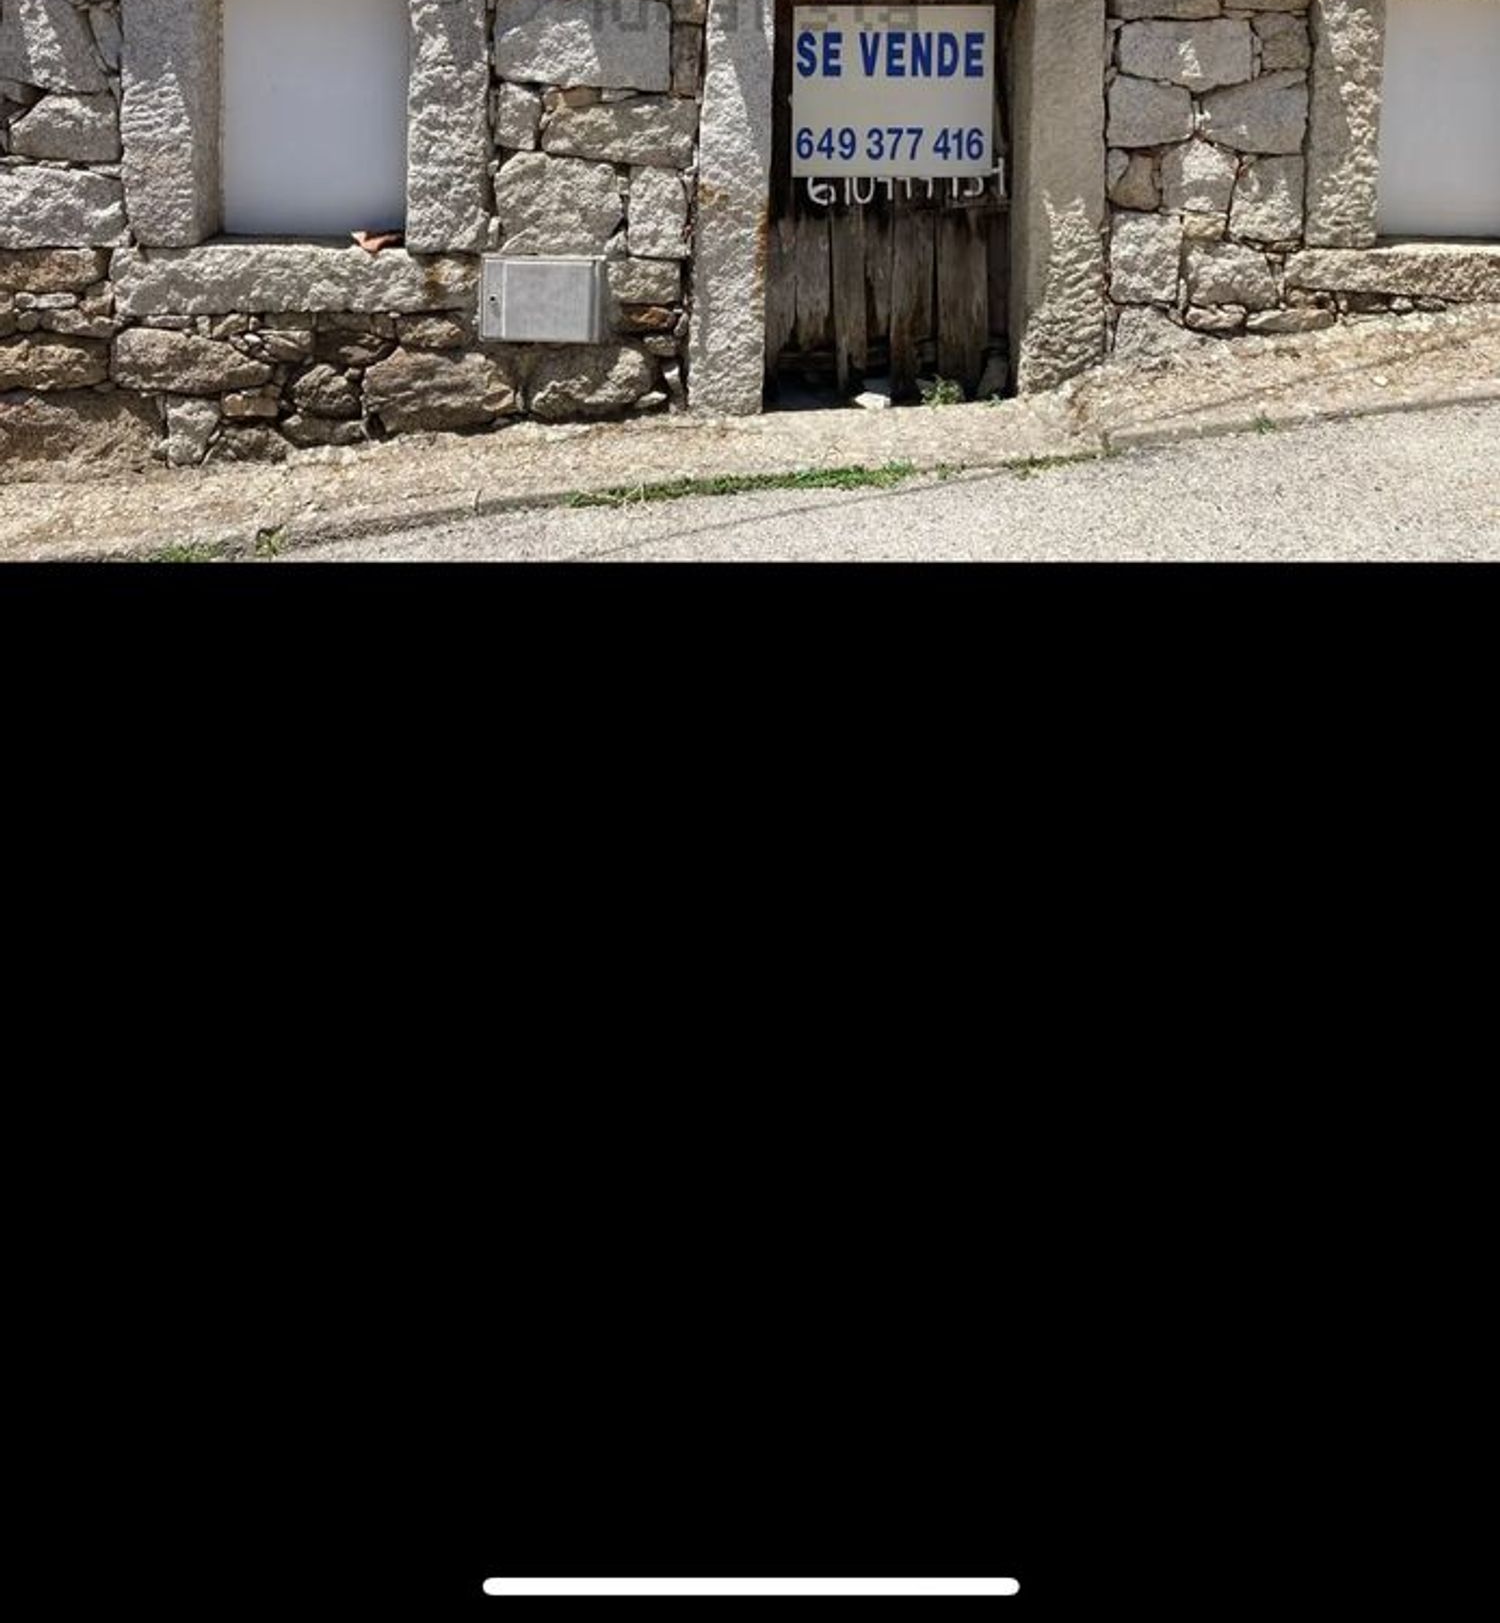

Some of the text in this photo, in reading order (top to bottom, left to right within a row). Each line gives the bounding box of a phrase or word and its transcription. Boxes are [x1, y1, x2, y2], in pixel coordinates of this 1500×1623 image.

[796, 31, 985, 77] SE VENDE
[796, 128, 984, 161] 649 377 416
